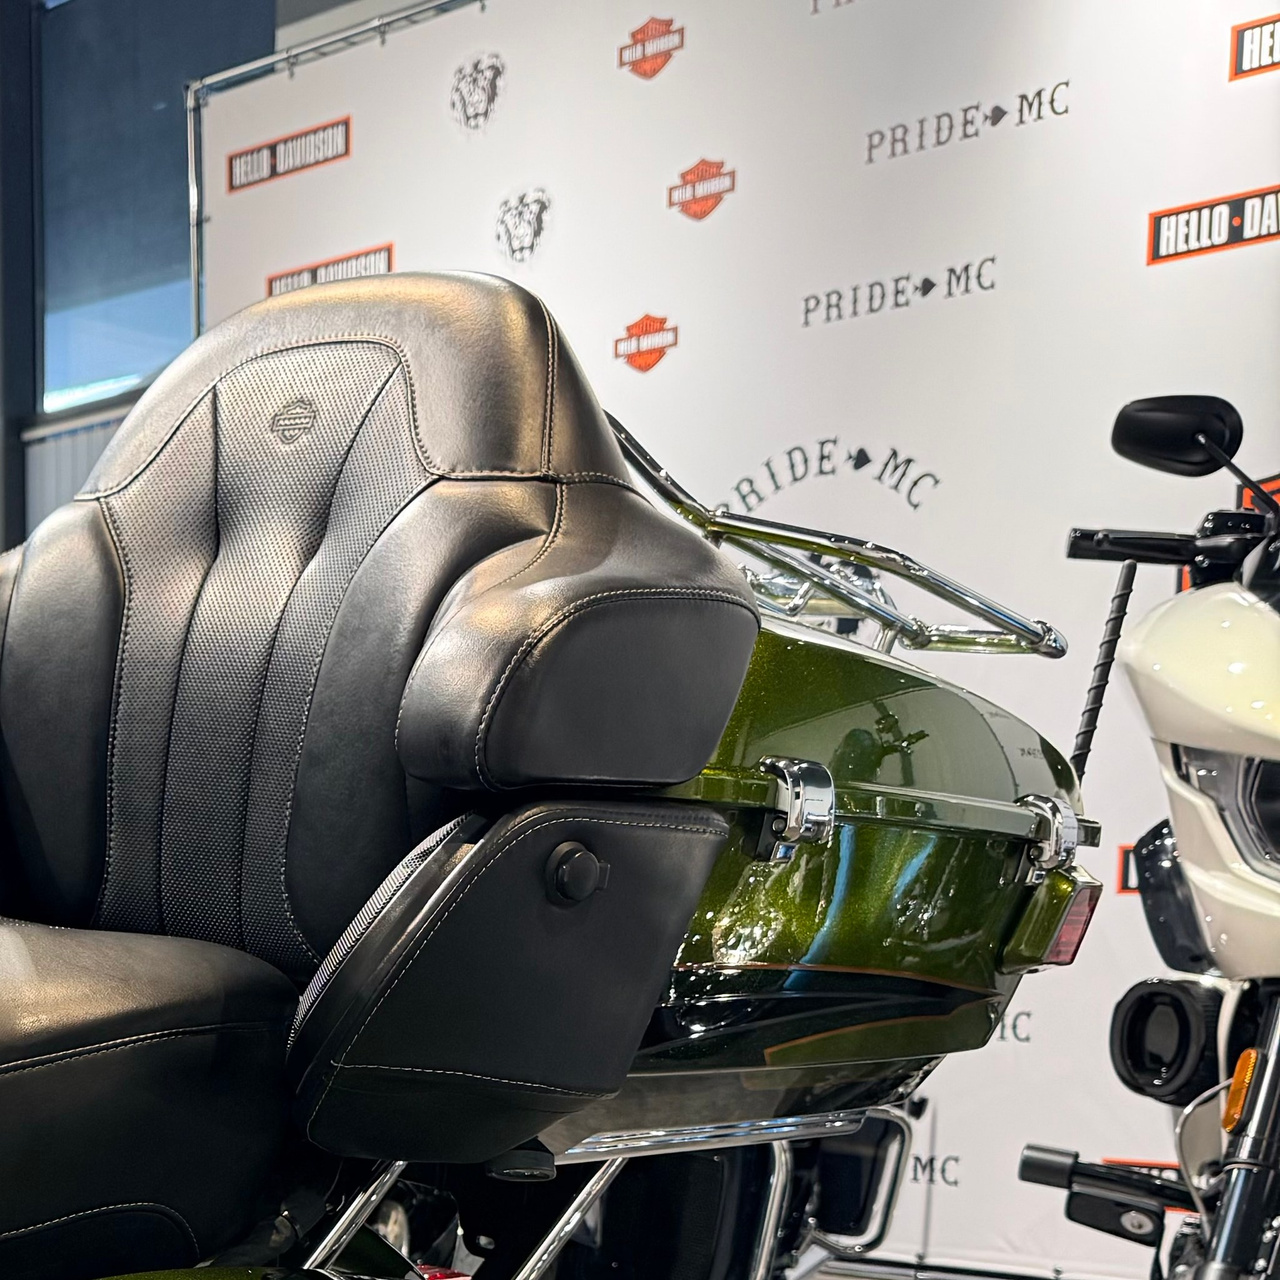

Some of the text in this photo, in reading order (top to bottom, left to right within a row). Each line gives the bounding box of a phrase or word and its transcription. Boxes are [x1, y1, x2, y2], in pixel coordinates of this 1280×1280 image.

[232, 122, 346, 188] HELLO DAVIDSON
[866, 80, 1070, 165] PRIDE MC
[1159, 192, 1280, 257] HELLO DA
[802, 255, 997, 328] PRIDE MC
[874, 448, 940, 510] MC
[912, 1154, 959, 1187] MC
